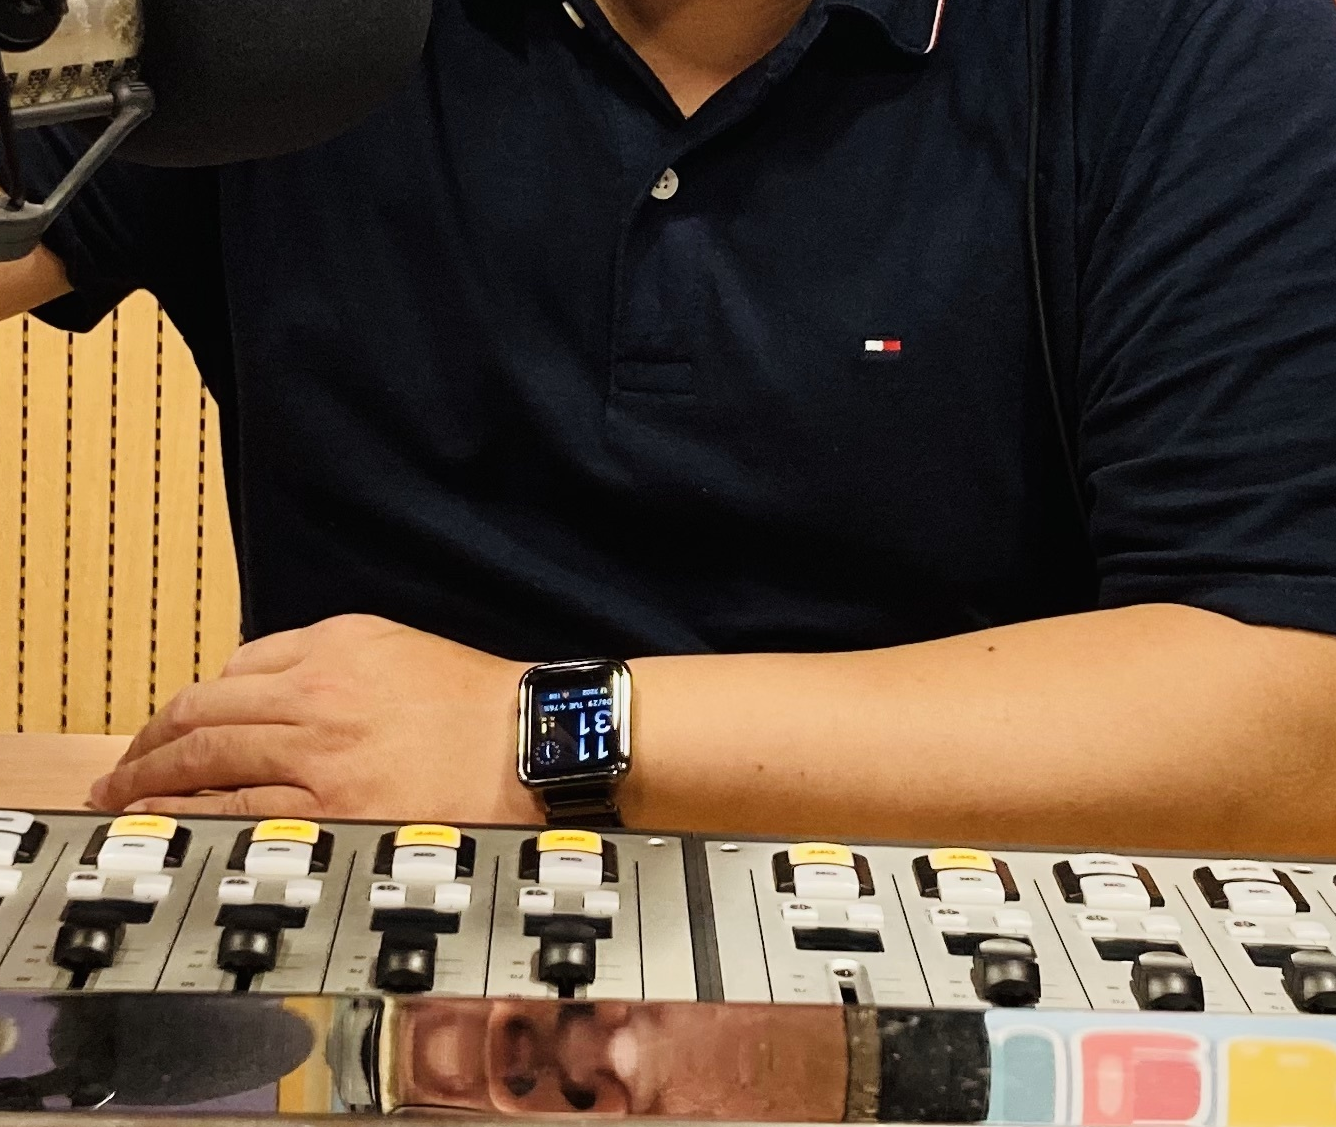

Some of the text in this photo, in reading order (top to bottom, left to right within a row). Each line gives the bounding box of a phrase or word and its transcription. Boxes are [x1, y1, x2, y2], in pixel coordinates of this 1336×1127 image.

[568, 701, 584, 711] TUE
[579, 710, 613, 736] 31
[578, 735, 609, 762] 11
